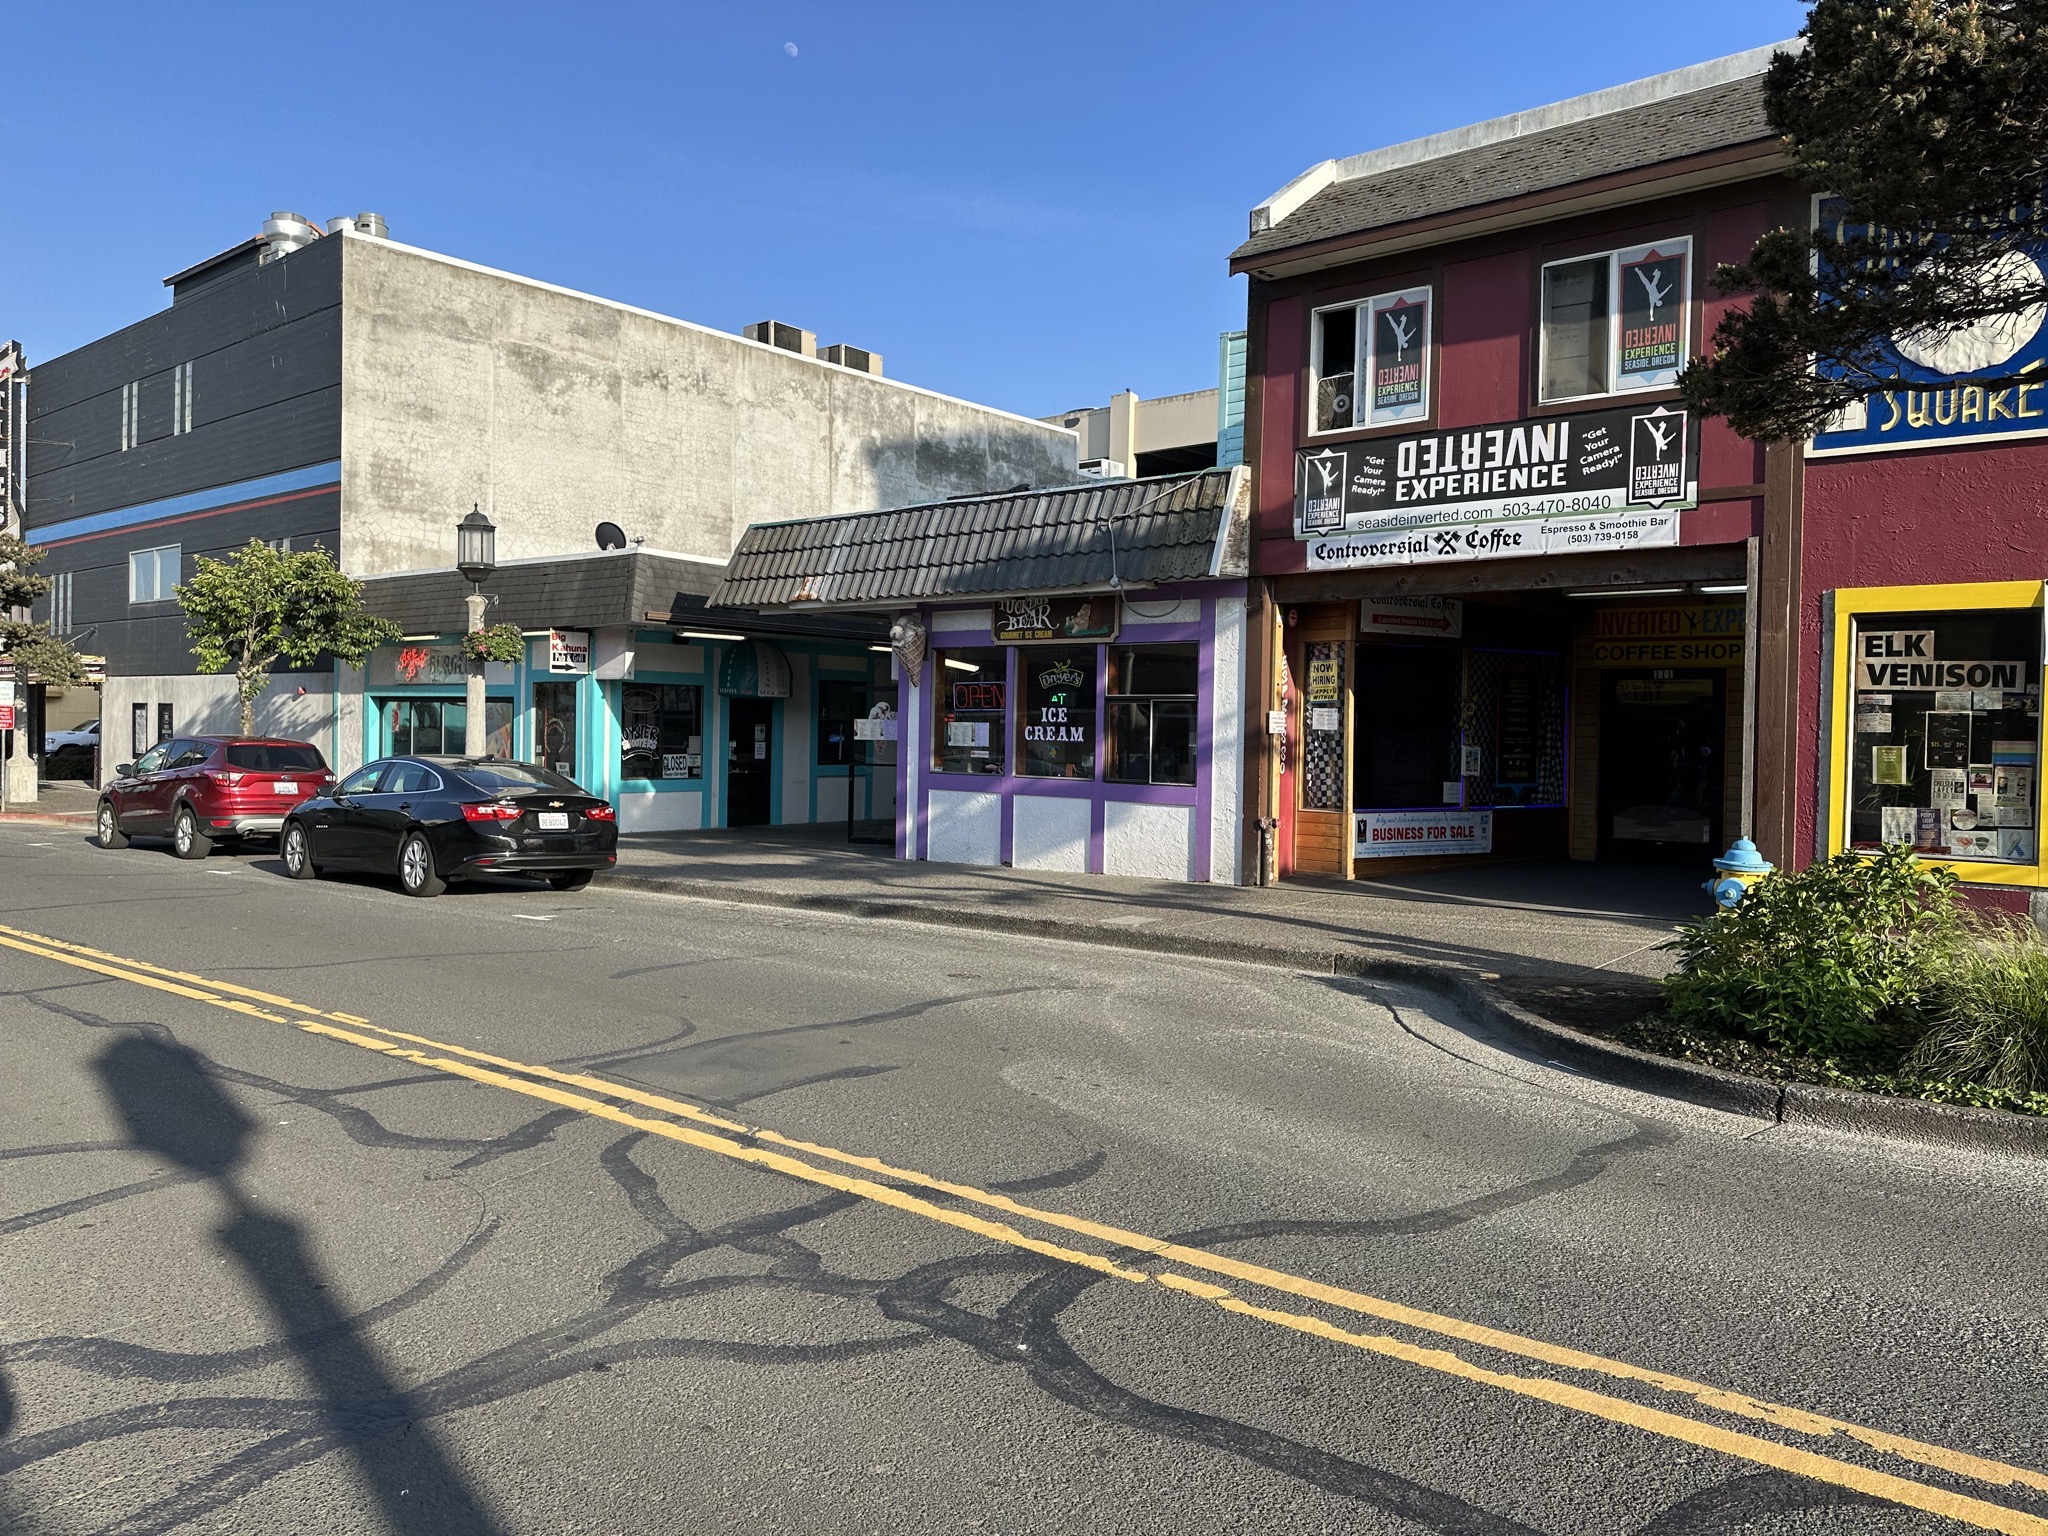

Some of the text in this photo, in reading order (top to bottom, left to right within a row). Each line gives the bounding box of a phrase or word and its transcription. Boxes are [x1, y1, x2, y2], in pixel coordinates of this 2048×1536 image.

[1625, 323, 1676, 349] INVERTED
[1625, 343, 1675, 360] EXPERIENCE
[1651, 354, 1675, 367] OREGON
[1378, 363, 1418, 385] INVERTED
[1377, 381, 1418, 396] EXPERIENCE
[1398, 391, 1418, 403] OREGON
[1397, 421, 1570, 478] INVERTED
[1584, 437, 1609, 452] Your
[1579, 445, 1620, 465] Camera
[1363, 466, 1383, 475] Your
[1635, 463, 1679, 480] INVERTED
[1354, 475, 1386, 486] Camera
[1396, 463, 1567, 502] EXPERIENCE
[1635, 478, 1678, 489] EXPERIENCE
[1657, 486, 1678, 495] OREGON
[1308, 497, 1340, 512] INVERTED
[1357, 495, 1611, 529] seasideinverted.com 503-470-8040
[1308, 510, 1339, 520] EXPERIENCE
[1540, 517, 1669, 535] Espresso & Smoothie Bar
[1315, 528, 1522, 560] Controversial Coffee
[1567, 530, 1639, 544] (503) 739-0158
[997, 604, 1060, 631] BEAR
[1595, 609, 1681, 636] INVERTED
[552, 632, 566, 642] Big
[1000, 630, 1053, 640] GOURMET ICE CREAM
[552, 643, 587, 653] Kahuna
[1594, 644, 1742, 661] COFFEE SHOP
[1865, 634, 1927, 657] ELK
[1313, 663, 1334, 673] NOW
[1866, 663, 2018, 688] VENISON
[1312, 675, 1335, 685] HIRING
[956, 685, 1006, 708] OPEN
[1041, 707, 1067, 723] ICE
[621, 724, 659, 741] OYSTER
[1024, 725, 1084, 742] CREAM
[664, 755, 686, 771] CLOSED
[1372, 827, 1424, 841] BUSINESS
[1427, 826, 1447, 839] FOR
[1450, 825, 1475, 839] SALE
